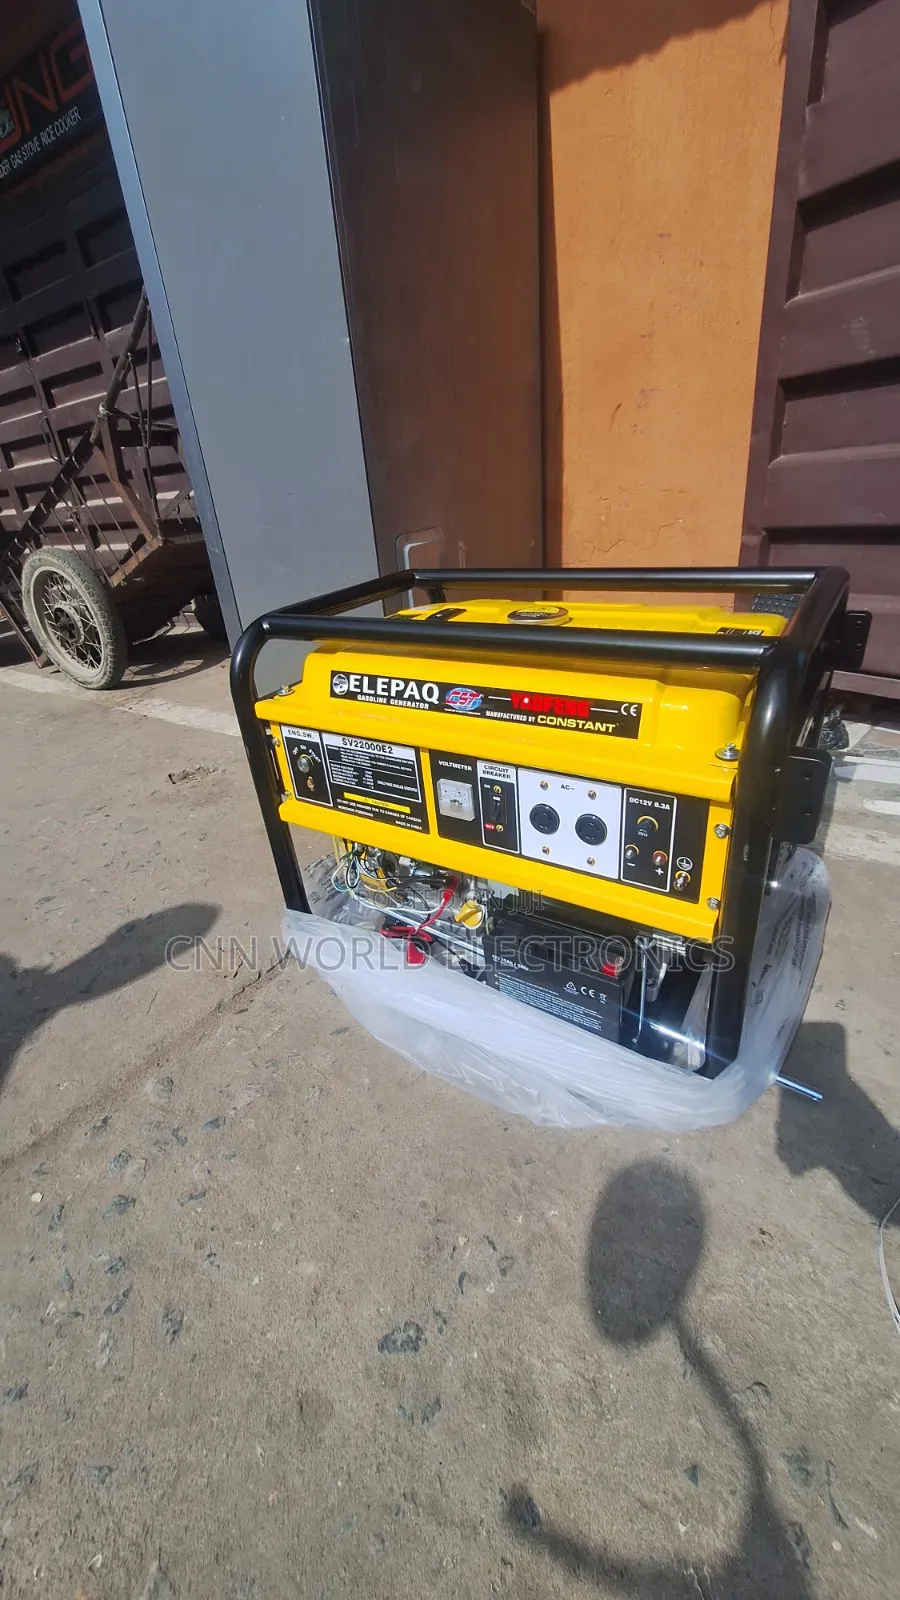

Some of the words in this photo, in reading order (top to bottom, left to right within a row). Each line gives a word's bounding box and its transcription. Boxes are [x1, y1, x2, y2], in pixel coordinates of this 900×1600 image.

[10, 150, 24, 168] GAS
[21, 136, 41, 161] STOVE
[40, 125, 56, 147] RICE
[54, 106, 81, 136] COOKER
[349, 674, 440, 704] ELEPAQ
[357, 694, 387, 704] GASOLINE
[390, 698, 429, 710] GENERATOR
[509, 691, 590, 717] YAOFENG
[485, 710, 527, 722] MANUFACTURED
[537, 714, 616, 733] CONSTANT
[341, 737, 394, 754] SV22000E2
[438, 760, 473, 771] VOLTMETER
[483, 764, 509, 773] CIRCUIT
[482, 770, 511, 779] BREAKER
[629, 797, 652, 807] DC12V
[654, 802, 671, 811] 8.3A
